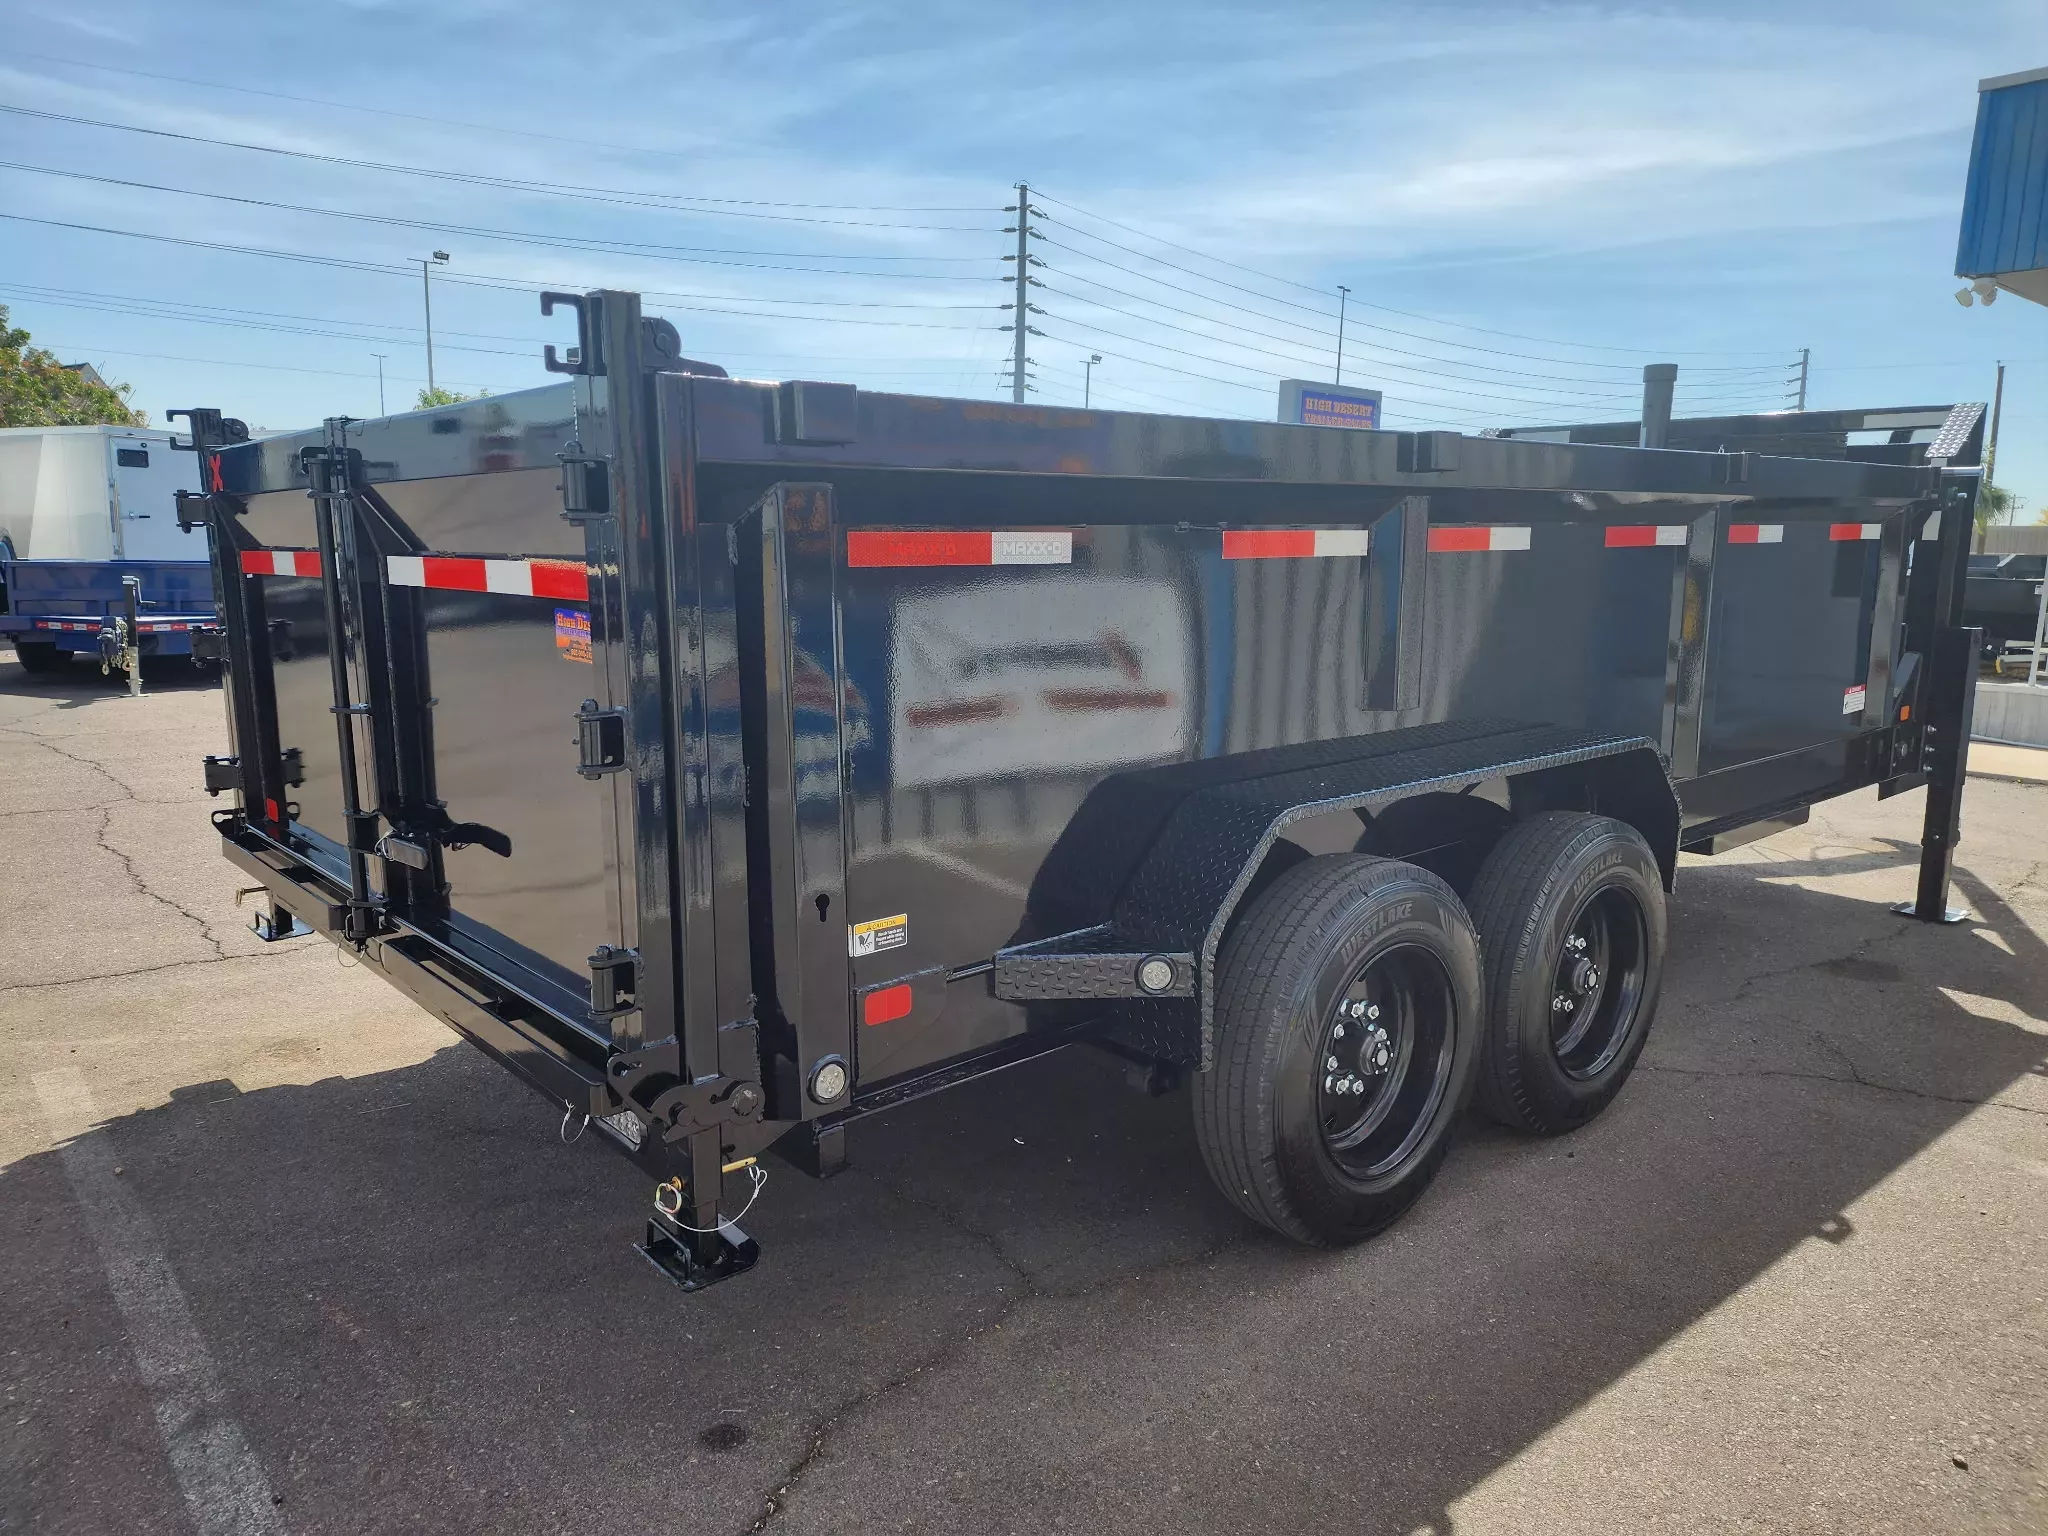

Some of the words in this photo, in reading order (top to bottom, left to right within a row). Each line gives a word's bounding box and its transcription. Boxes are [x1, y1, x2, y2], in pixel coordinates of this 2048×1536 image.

[1306, 398, 1332, 413] HIGH
[1334, 401, 1373, 416] DESERT
[1304, 413, 1343, 426] TRAILER
[1002, 541, 1063, 556] MAXX-D
[872, 920, 896, 930] CAUTION
[1341, 903, 1413, 965] WESTLAKE
